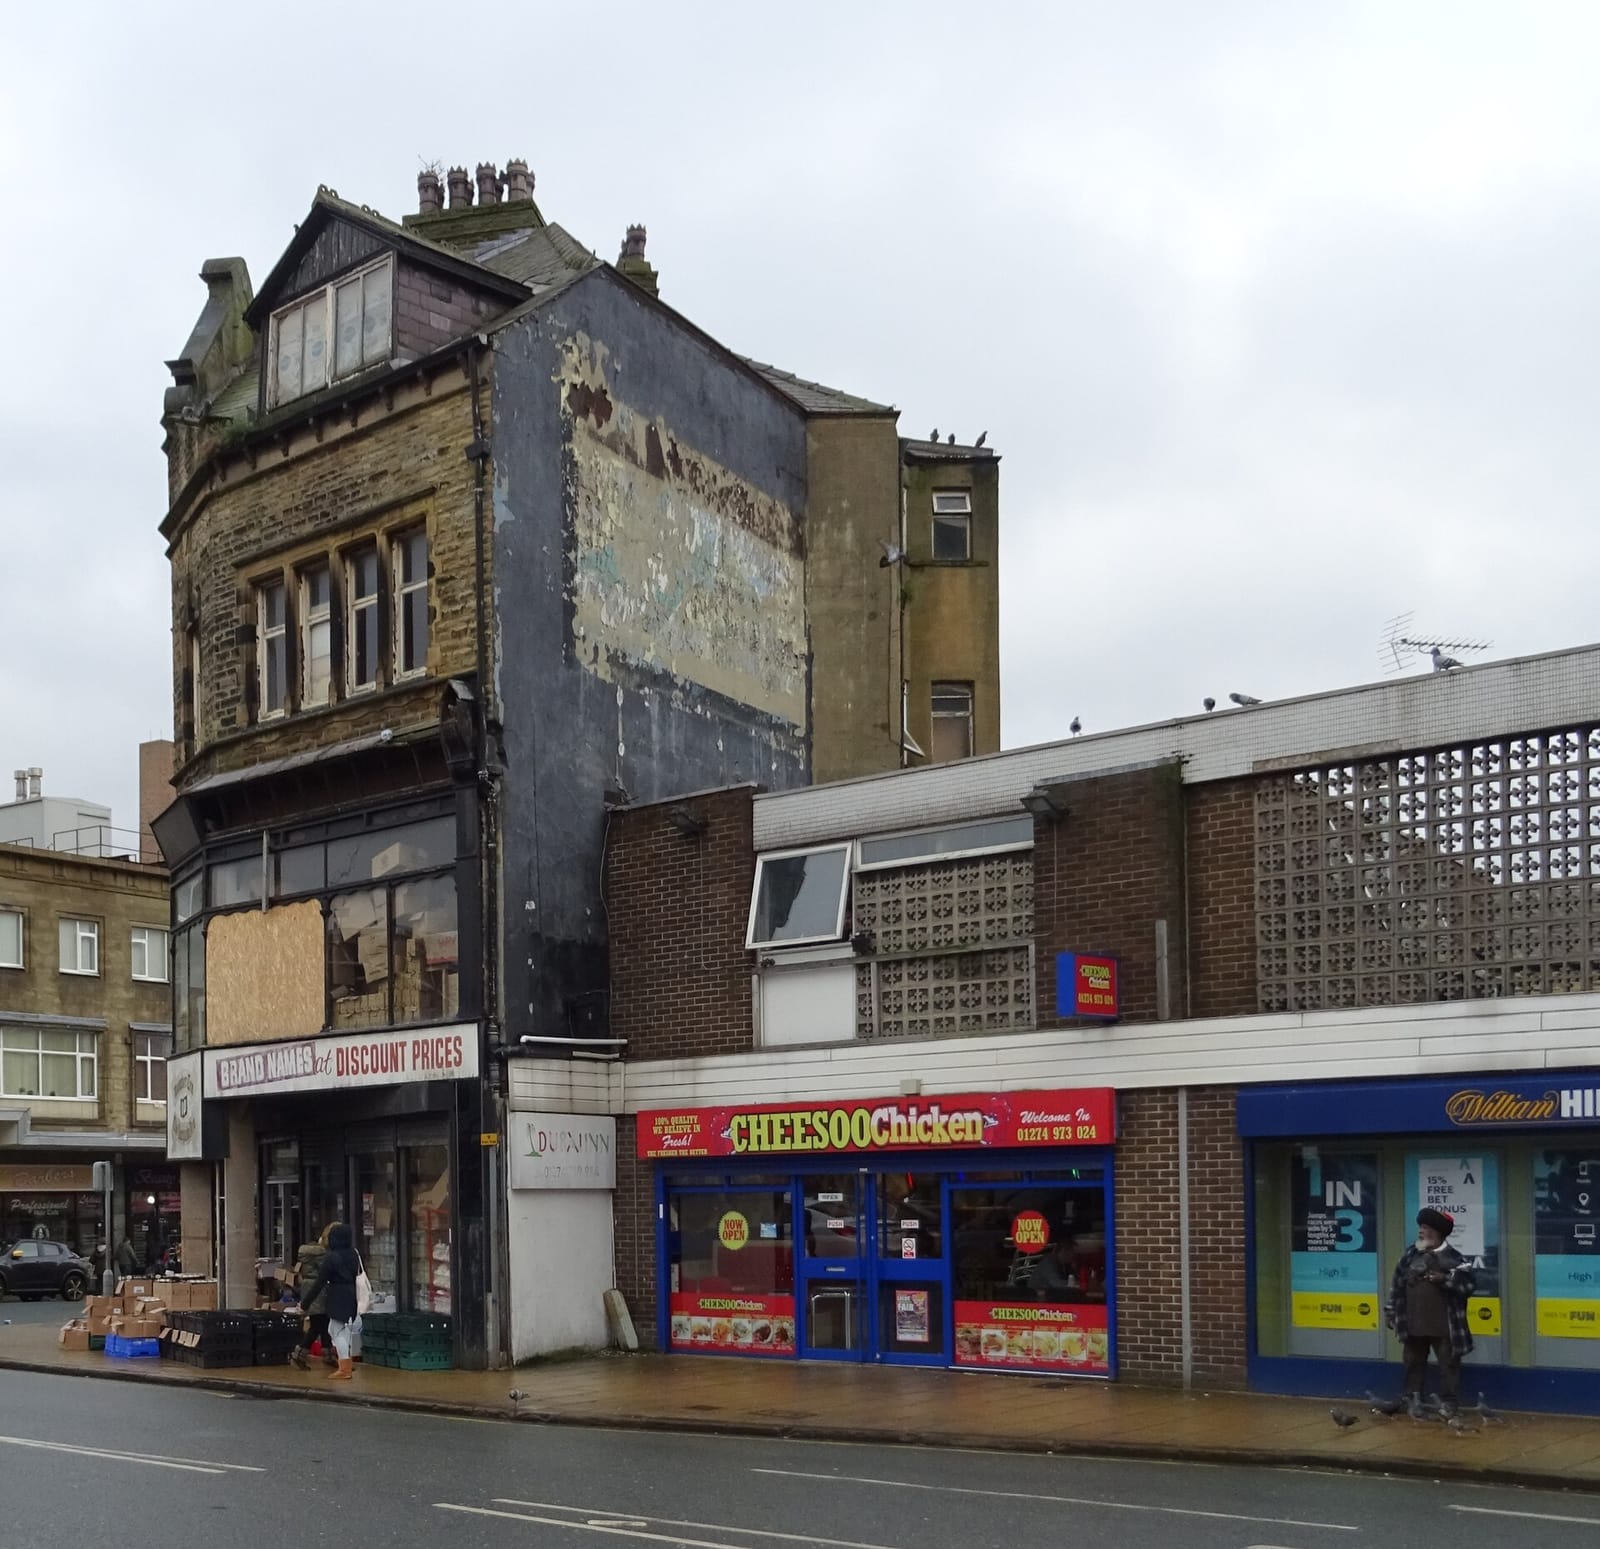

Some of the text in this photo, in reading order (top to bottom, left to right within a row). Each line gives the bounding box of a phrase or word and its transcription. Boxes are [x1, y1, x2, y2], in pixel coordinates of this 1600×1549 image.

[220, 1055, 264, 1089] BRAND
[267, 1046, 313, 1079] NAMES
[315, 1056, 333, 1075] at
[336, 1040, 407, 1077] DISCOUNT
[412, 1035, 463, 1070] PRICES
[1446, 1089, 1559, 1124] William
[671, 1115, 698, 1125] QUALITY
[1020, 1108, 1090, 1124] Welcome In
[653, 1124, 701, 1135] WE BELIEVE IN
[1017, 1125, 1096, 1142] 01274 973 024
[1427, 1175, 1448, 1185] 15%
[1325, 1181, 1361, 1207] IN
[1427, 1185, 1454, 1194] FREE
[1427, 1195, 1449, 1204] BET
[724, 1218, 743, 1230] NOW
[1017, 1218, 1042, 1231] NOW
[1334, 1209, 1364, 1251] 3
[722, 1230, 745, 1241] OPEN
[1015, 1231, 1045, 1244] OPEN
[1320, 1304, 1342, 1313] FUN
[1569, 1311, 1596, 1321] FUN
